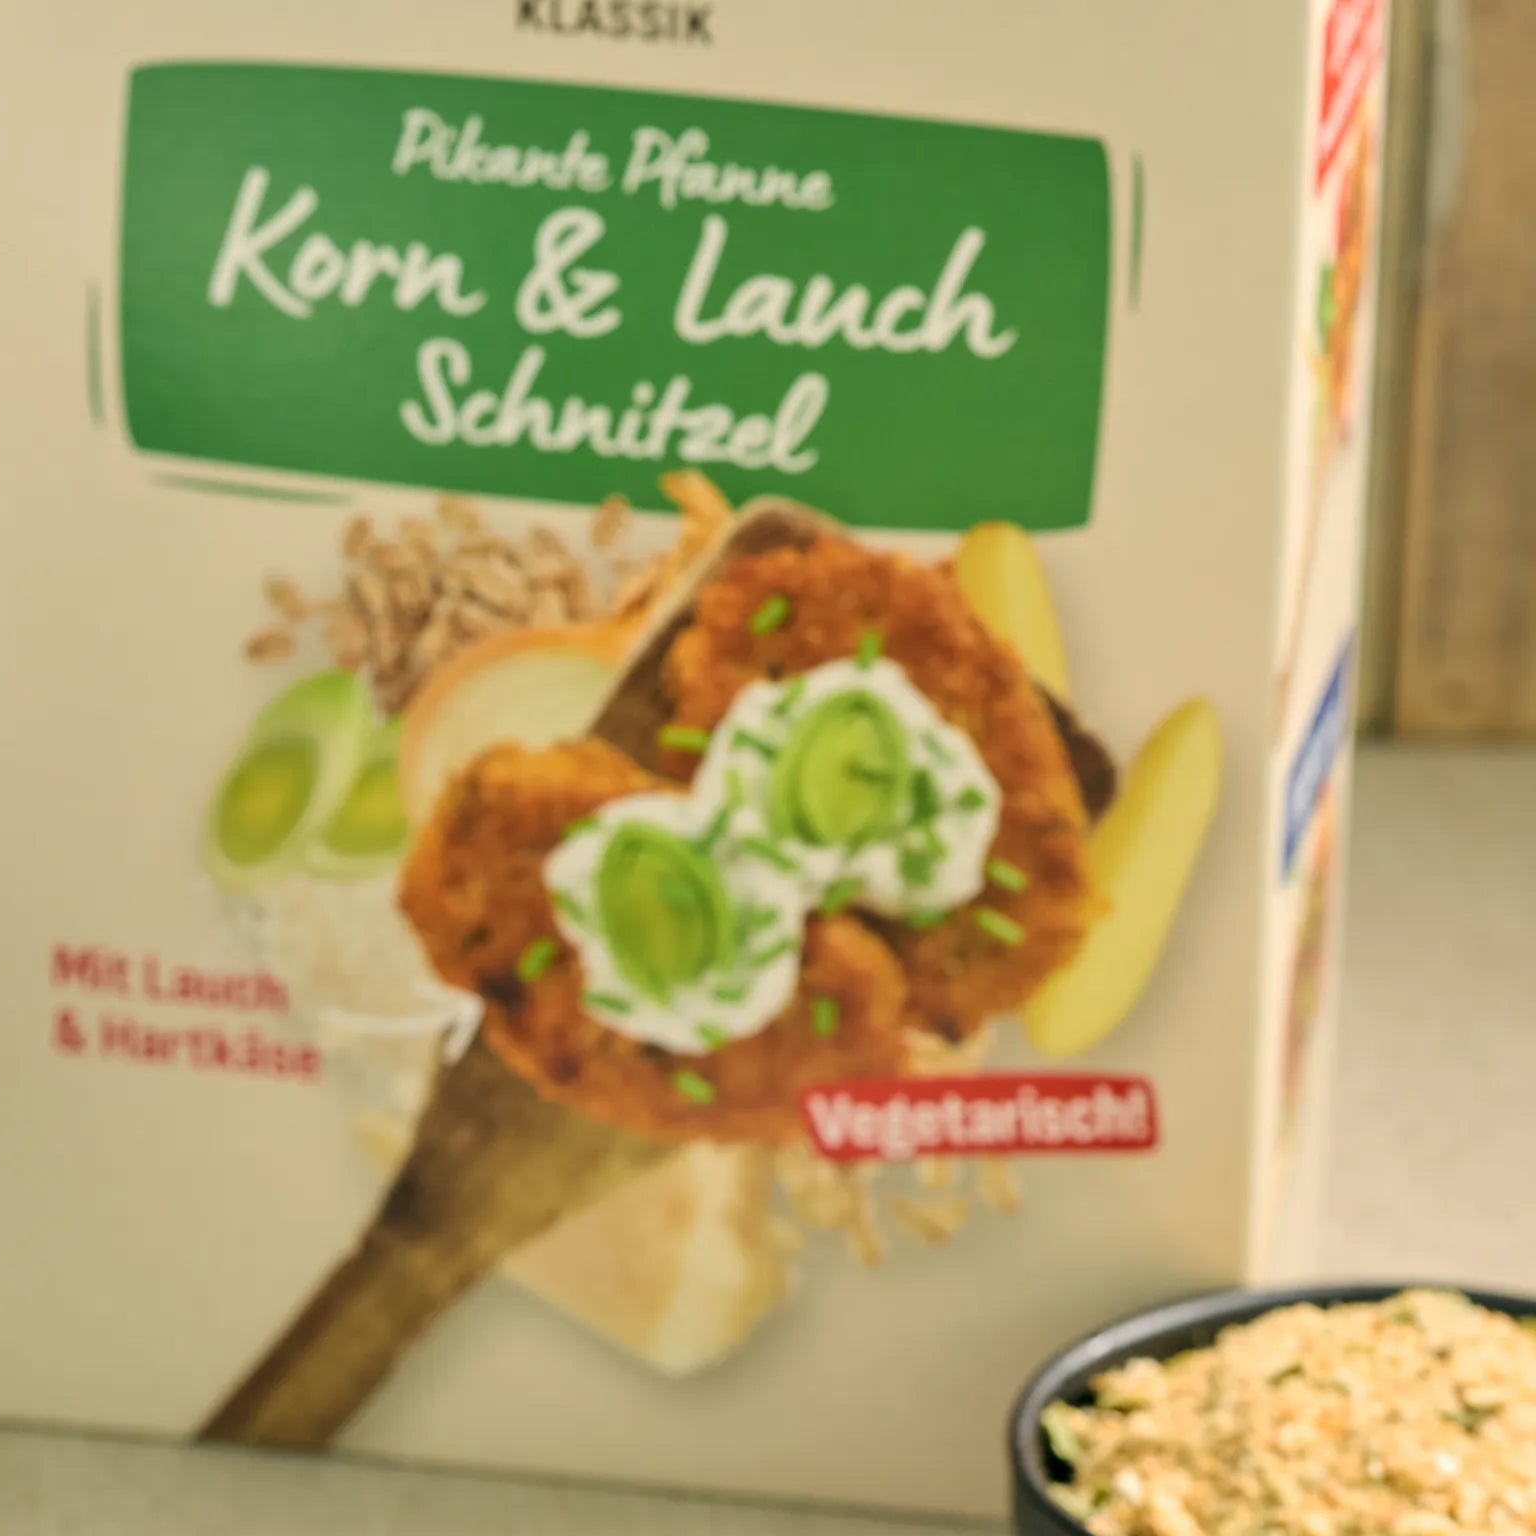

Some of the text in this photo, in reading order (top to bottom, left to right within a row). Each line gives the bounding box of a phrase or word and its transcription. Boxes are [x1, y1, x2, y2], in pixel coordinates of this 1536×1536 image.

[515, 0, 714, 45] KLASSIK
[392, 108, 836, 210] Pikante Pfanne
[208, 166, 1018, 359] Korn & Lauch
[400, 338, 828, 473] Schnitzel
[50, 944, 289, 1013] Mit Lauch
[52, 1003, 321, 1081] & Hartkäse
[807, 1084, 1150, 1160] Vegetarisch!
